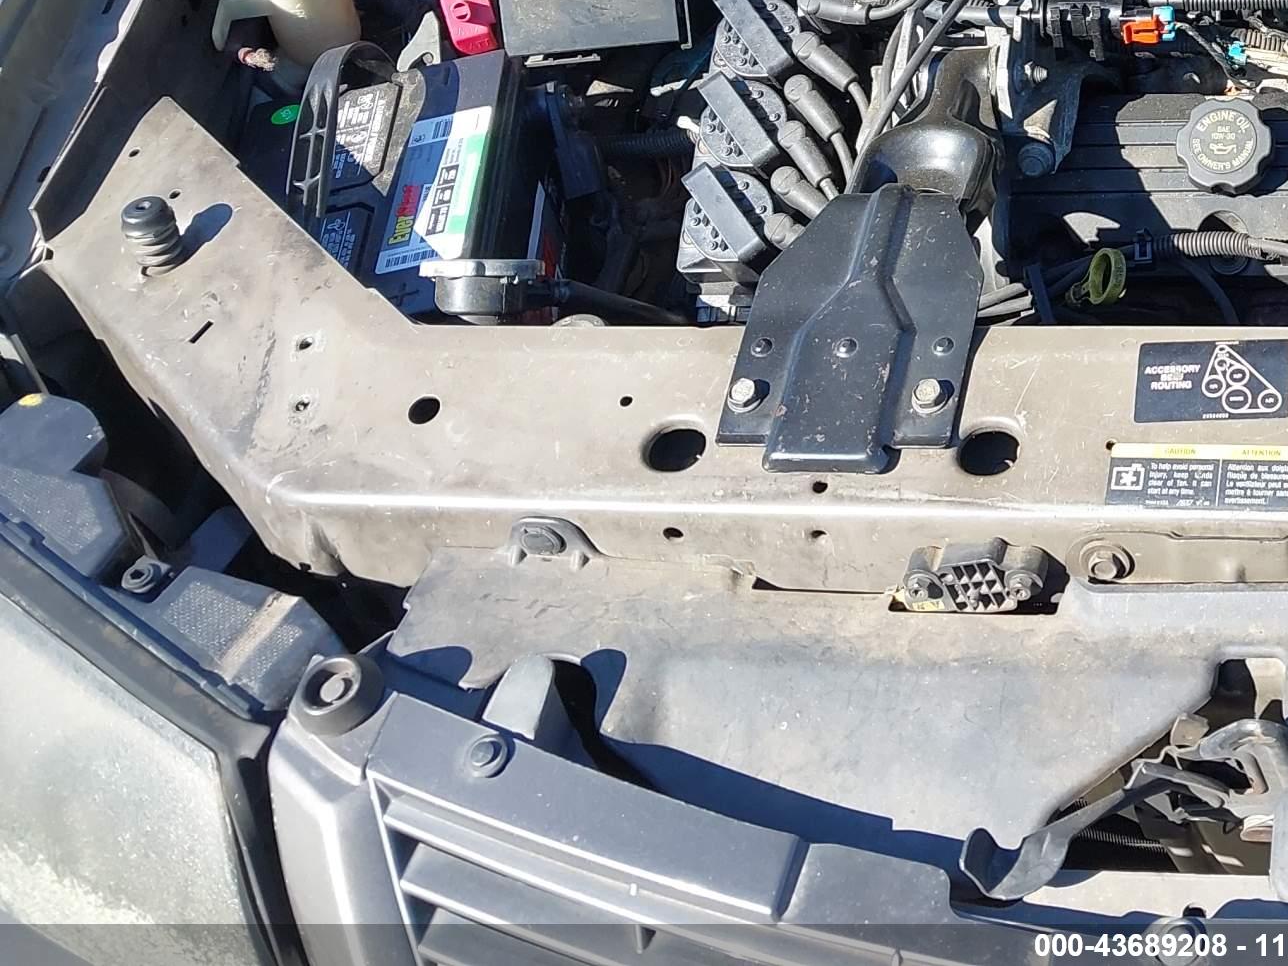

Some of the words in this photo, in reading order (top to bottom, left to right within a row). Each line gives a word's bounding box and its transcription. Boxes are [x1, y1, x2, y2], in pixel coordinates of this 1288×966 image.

[1195, 110, 1236, 132] ENGINE
[1236, 116, 1250, 133] OIL
[1211, 132, 1236, 140] 10W-30
[1192, 138, 1202, 155] SEE
[1198, 154, 1231, 170] OWNER'S
[1231, 138, 1254, 167] MANUAL
[1144, 364, 1201, 375] ACCESSORY
[1150, 380, 1193, 390] ROUTING
[1241, 449, 1282, 457] ATTENTION
[1158, 463, 1171, 471] help
[1189, 464, 1214, 472] personal
